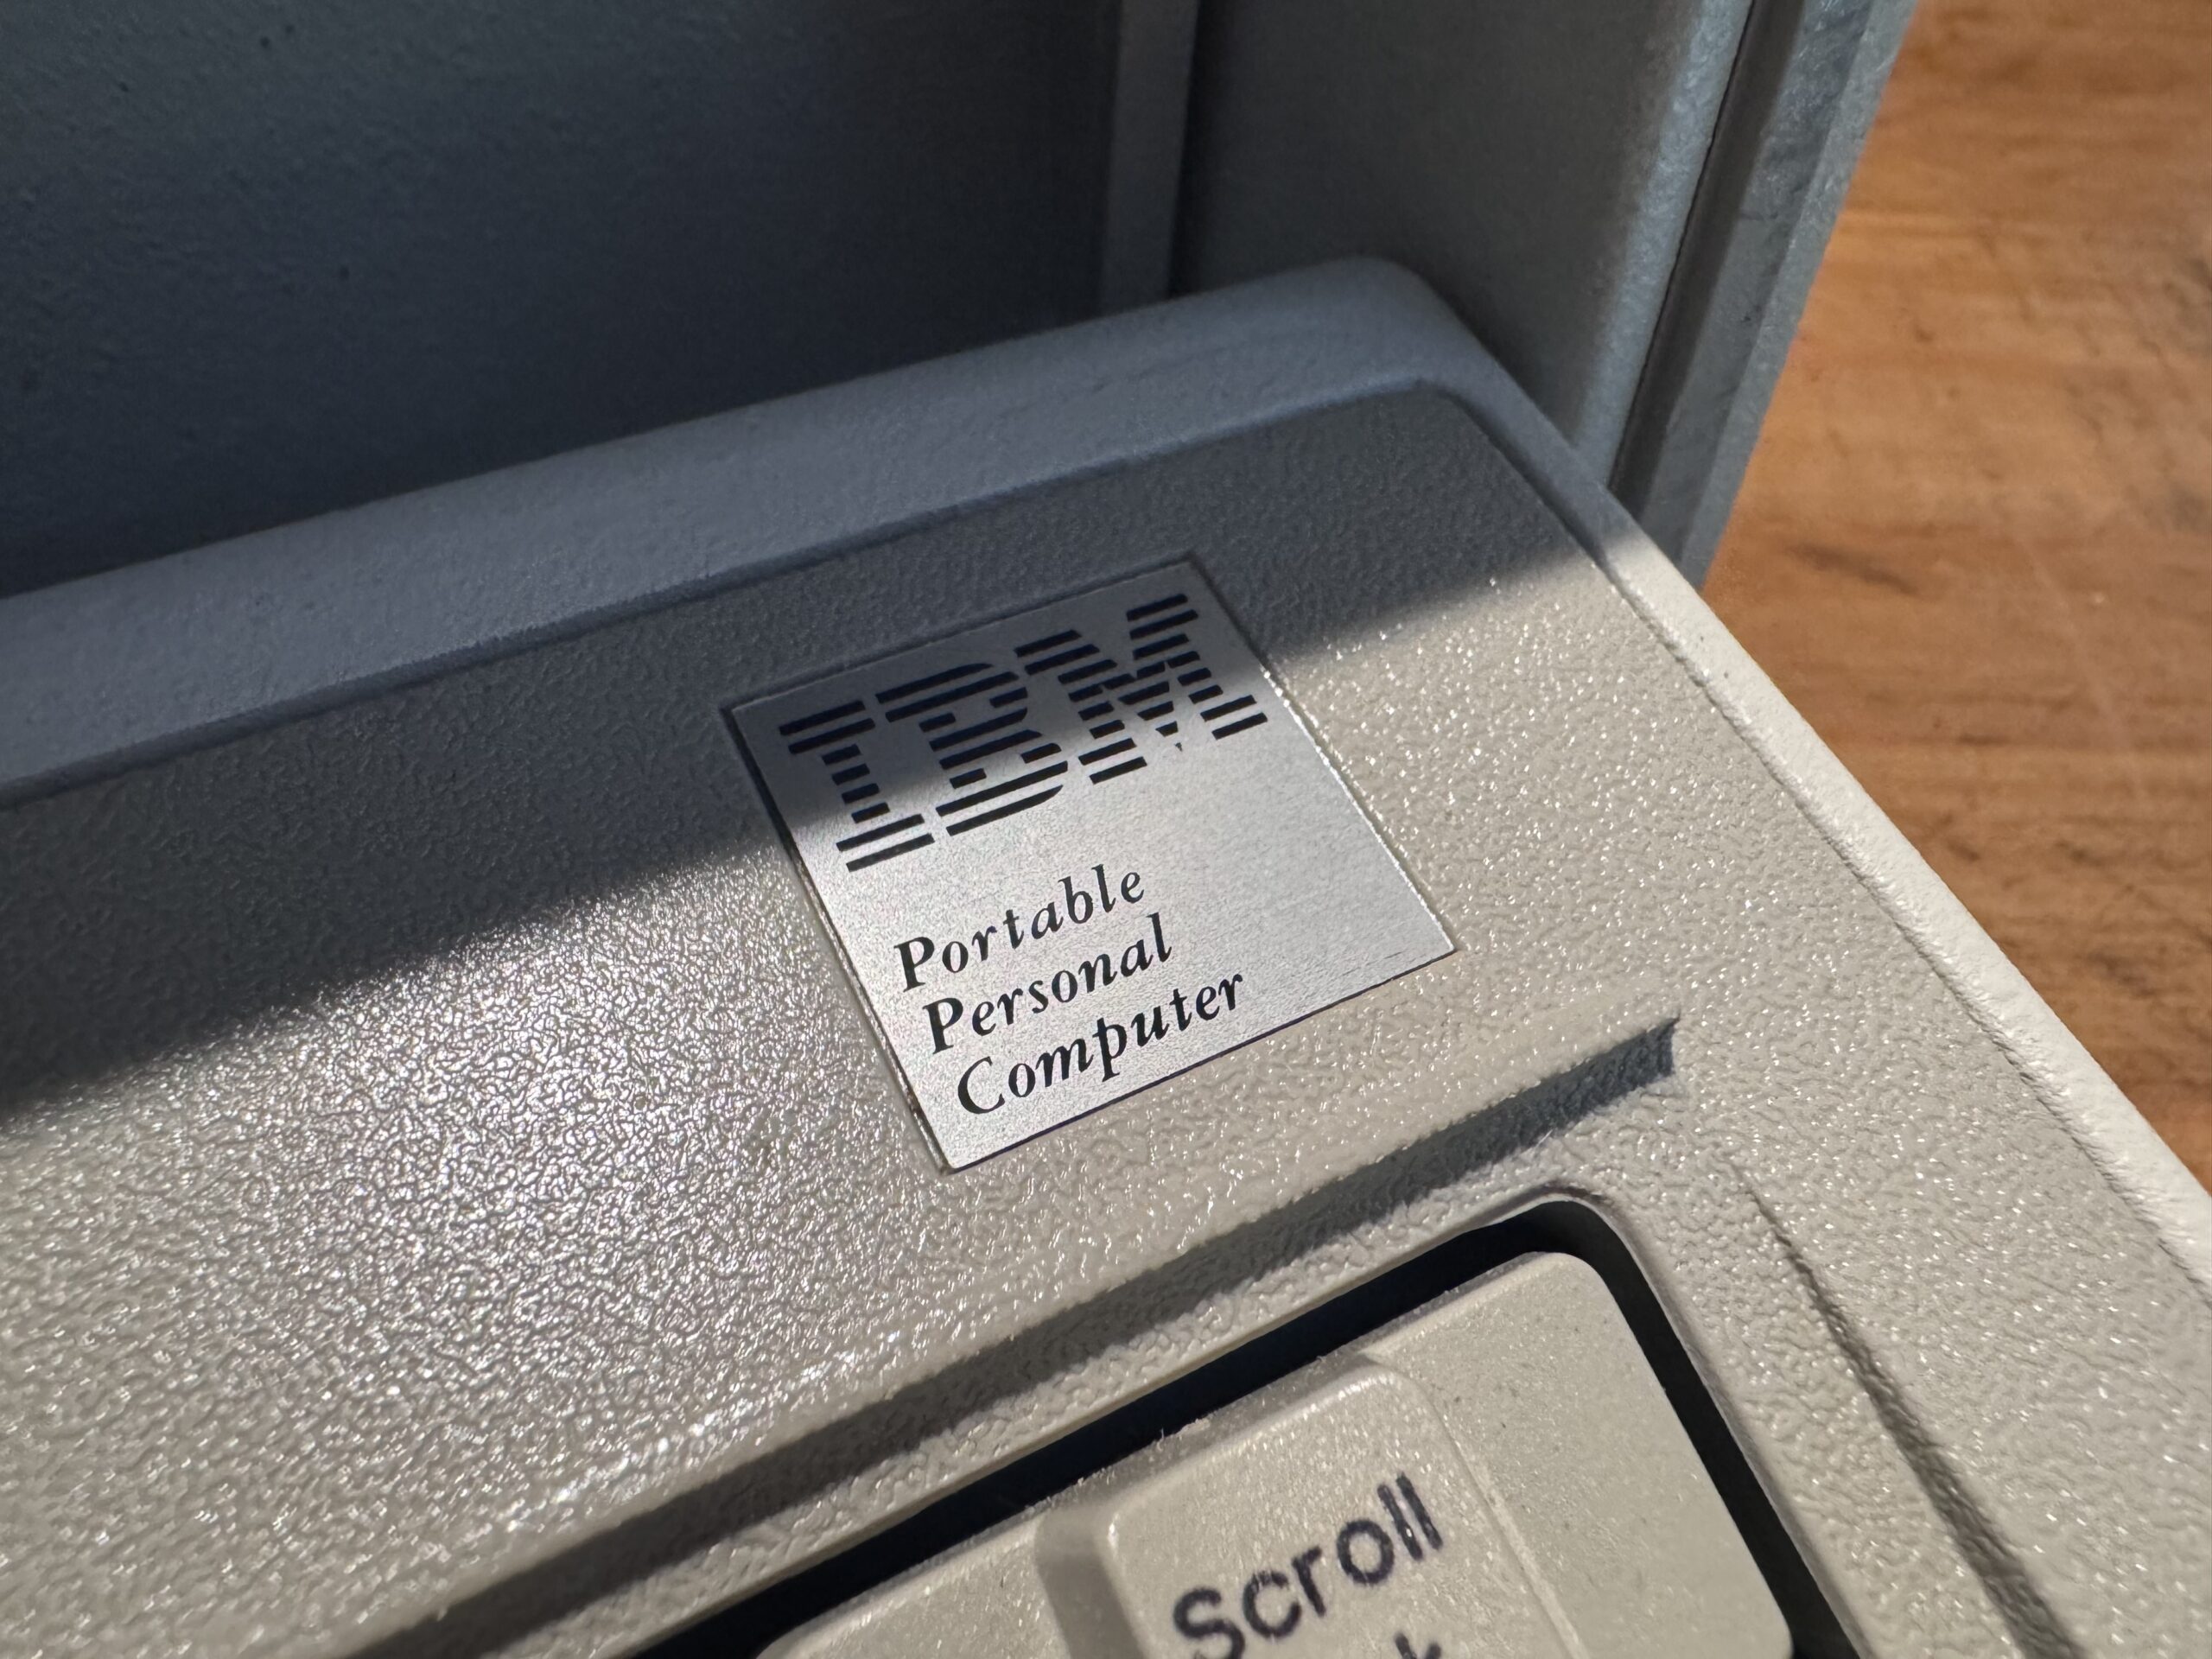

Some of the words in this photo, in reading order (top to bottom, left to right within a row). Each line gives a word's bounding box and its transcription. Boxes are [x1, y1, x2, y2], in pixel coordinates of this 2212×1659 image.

[779, 593, 1268, 873] IBM
[893, 864, 1146, 991] Portable
[922, 912, 1173, 1054] Personal
[957, 973, 1243, 1116] Computer
[1173, 1471, 1443, 1659] Scroll
